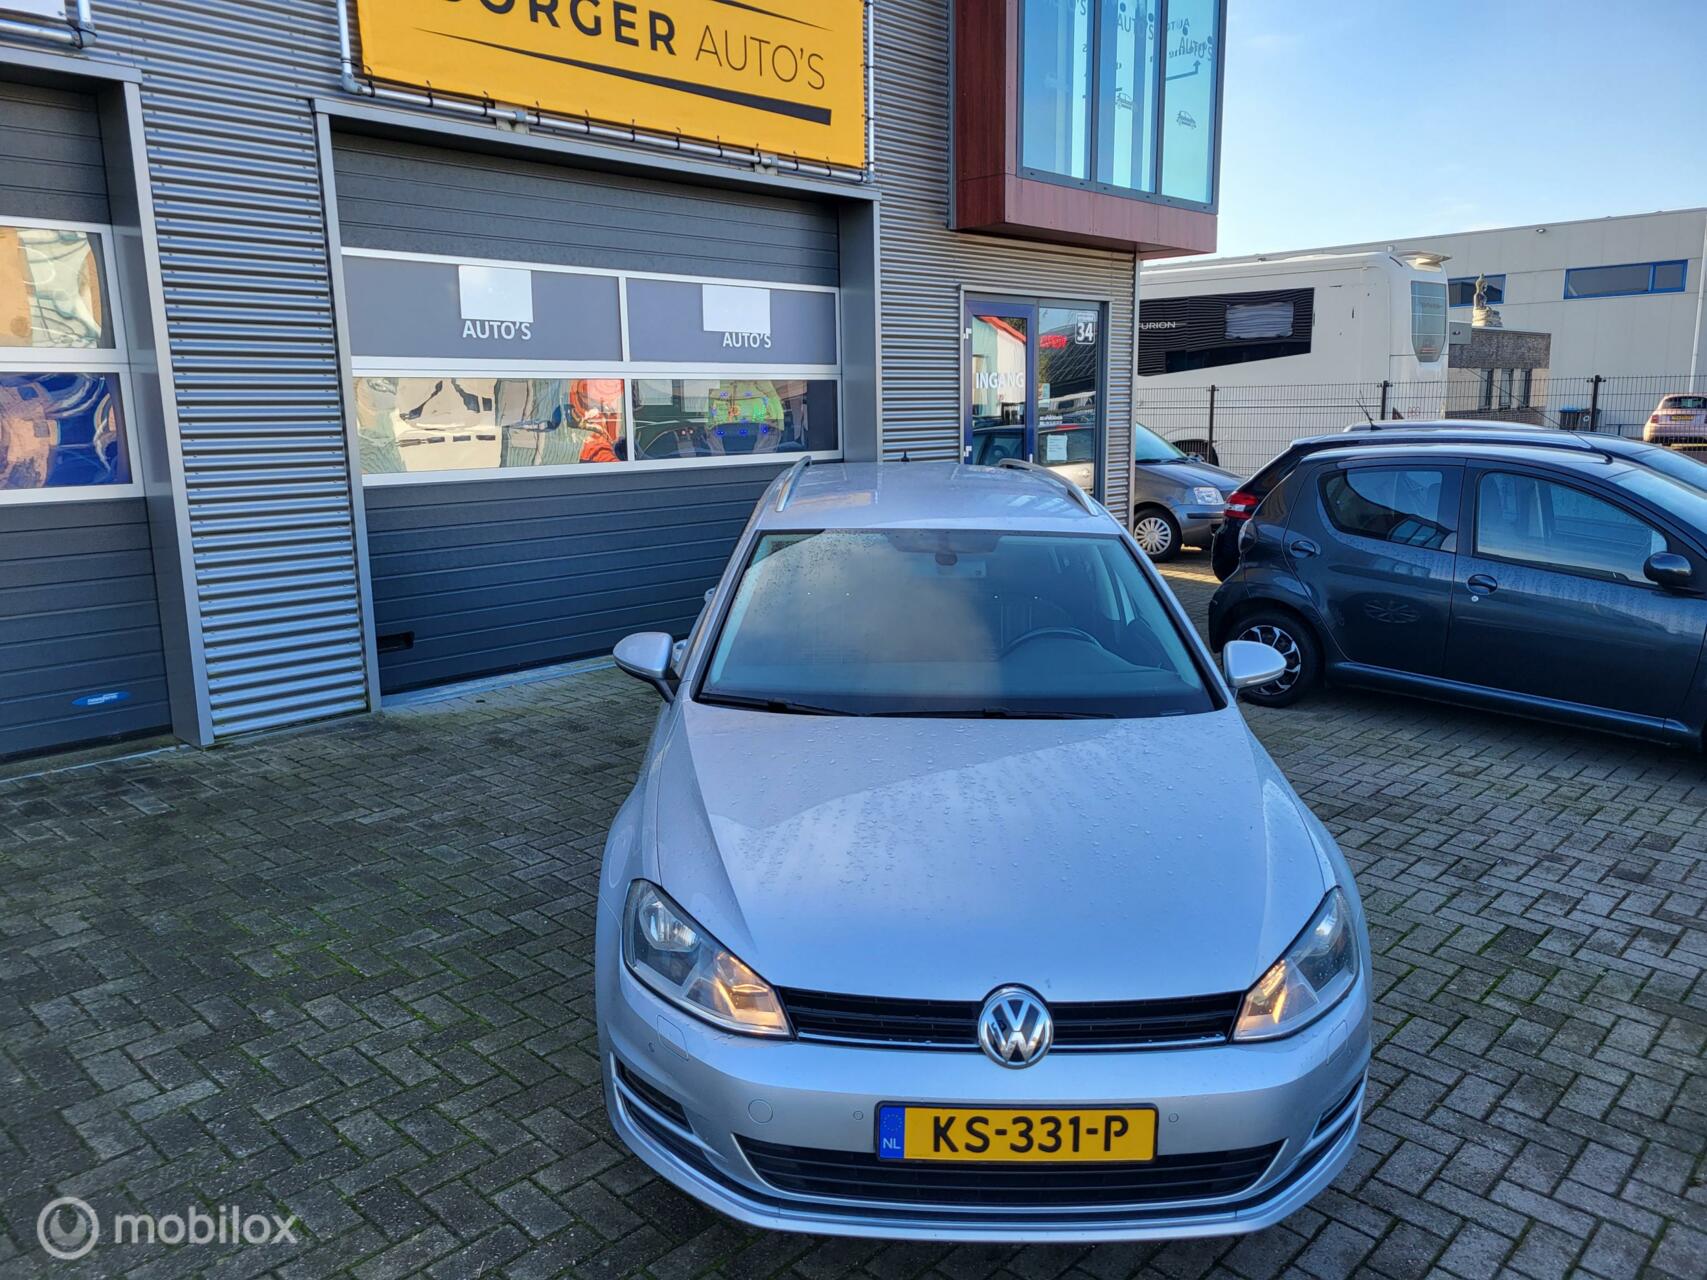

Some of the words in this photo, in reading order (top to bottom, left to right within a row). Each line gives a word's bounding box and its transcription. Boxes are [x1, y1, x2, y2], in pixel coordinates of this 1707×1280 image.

[696, 25, 826, 91] AUTO'S
[462, 320, 532, 340] AUTO'S
[722, 332, 772, 348] AUTO'S
[1077, 321, 1094, 341] 34
[975, 371, 1025, 390] INGANG
[882, 1138, 901, 1150] NL
[932, 1115, 1129, 1153] KS-331-P
